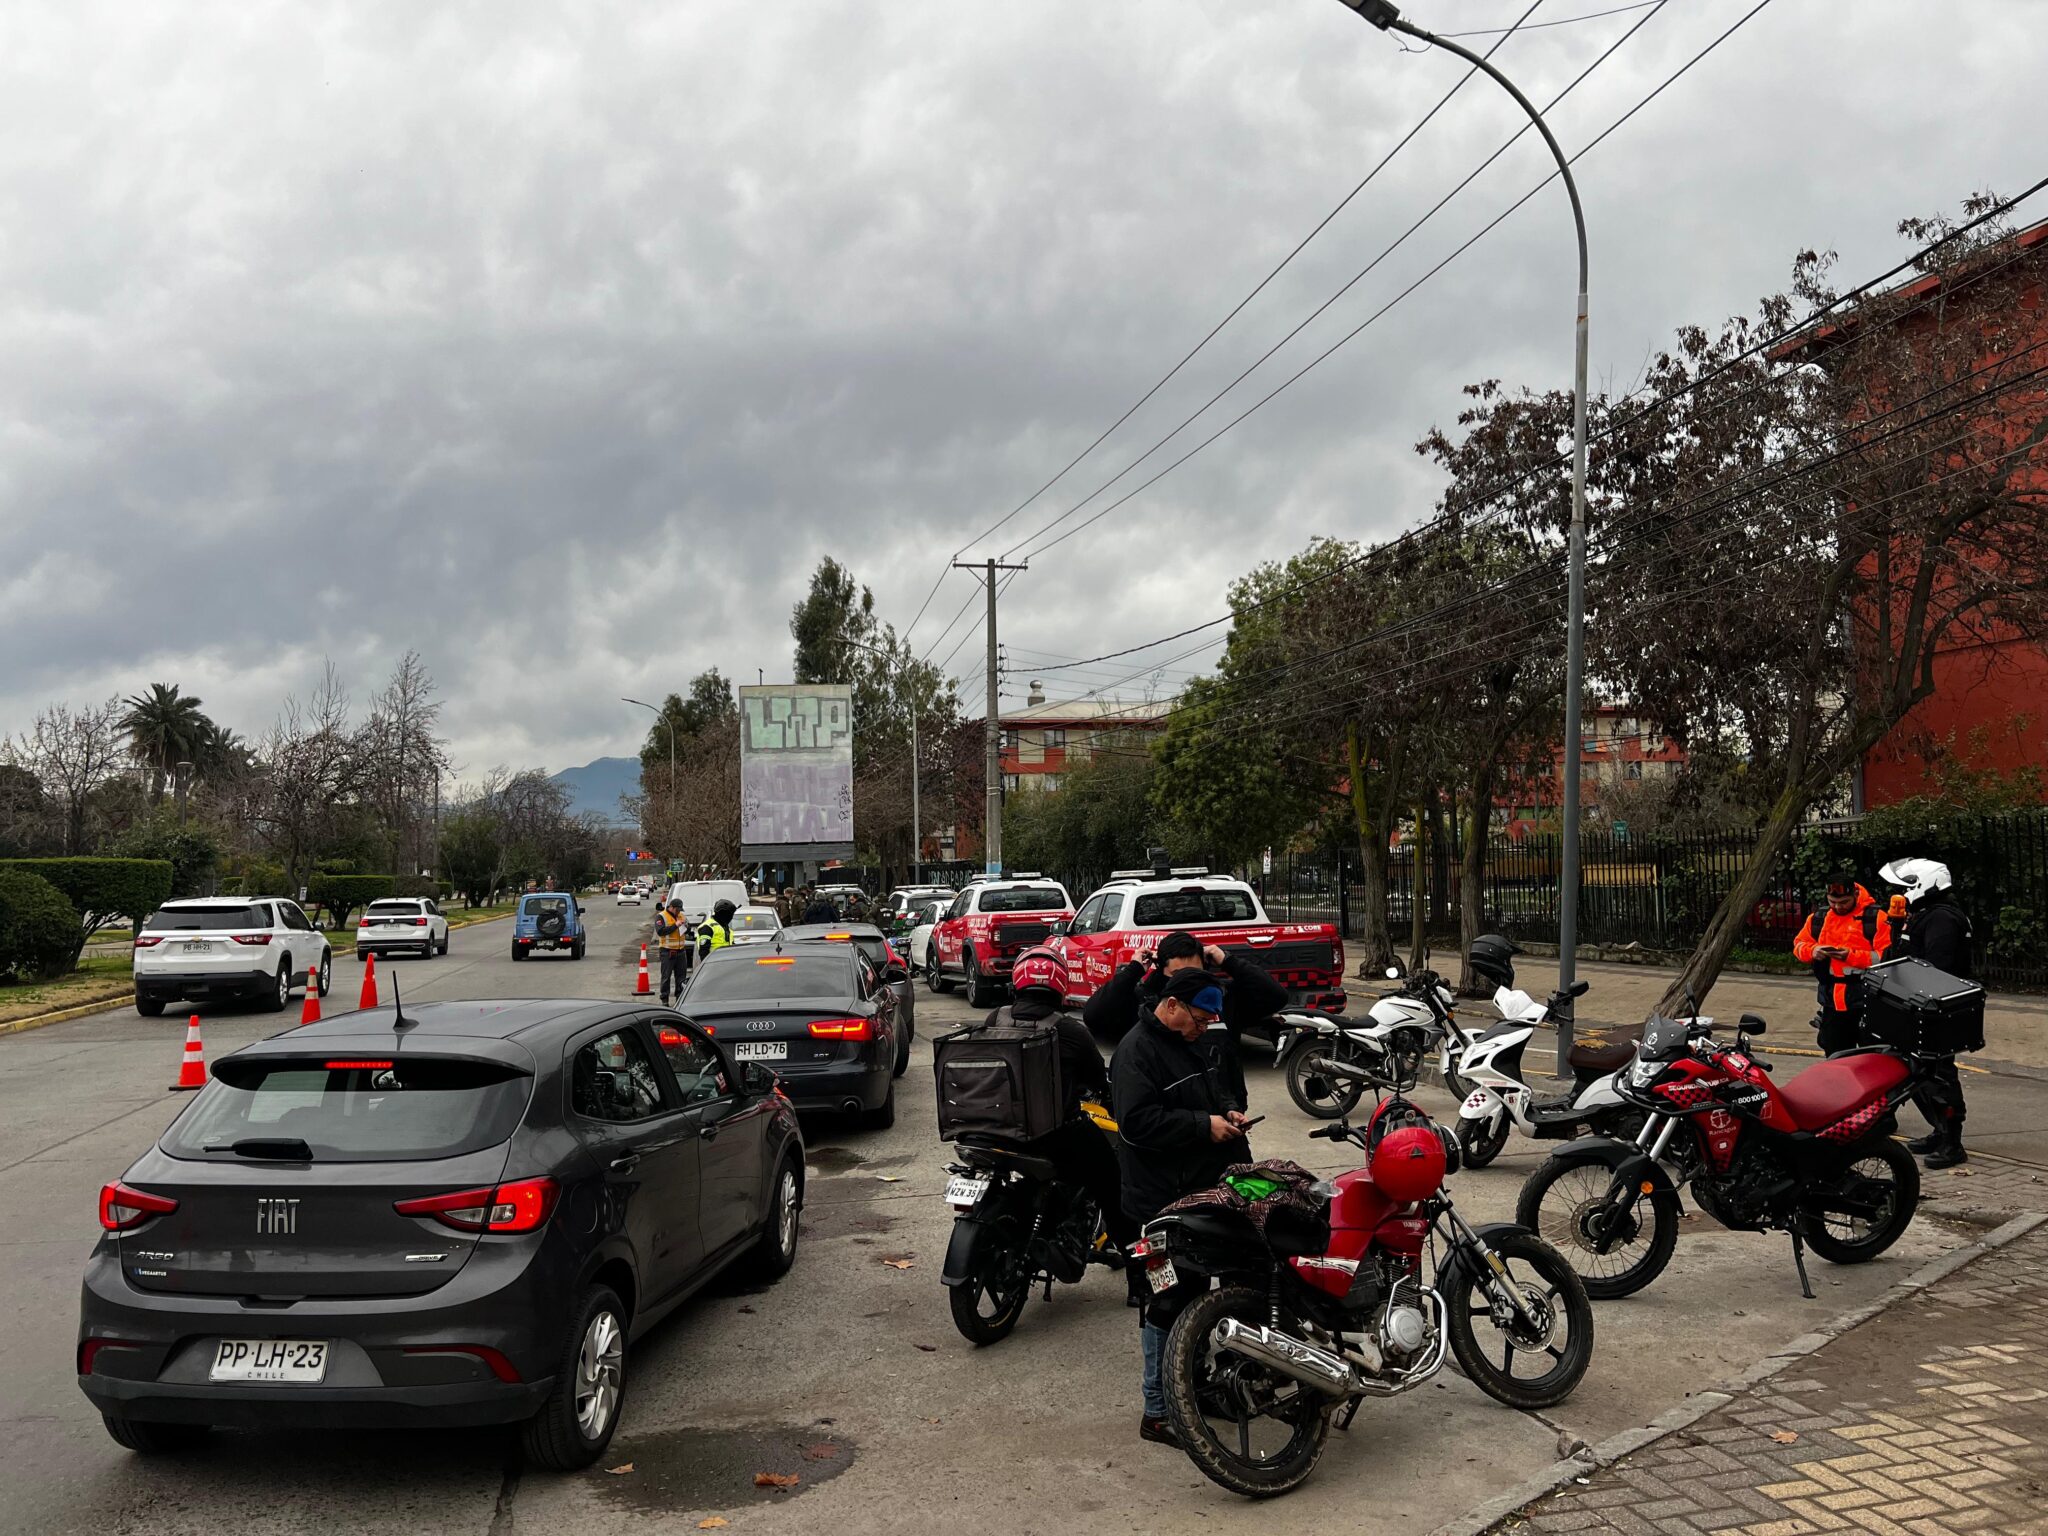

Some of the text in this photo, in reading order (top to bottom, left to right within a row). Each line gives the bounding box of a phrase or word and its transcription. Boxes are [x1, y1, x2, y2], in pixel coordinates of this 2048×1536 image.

[1738, 1096, 1751, 1104] 800
[1709, 1126, 1737, 1136] Rancagua
[257, 1198, 300, 1234] FIAT
[135, 1251, 174, 1260] ARGO
[247, 1371, 285, 1379] CHILE
